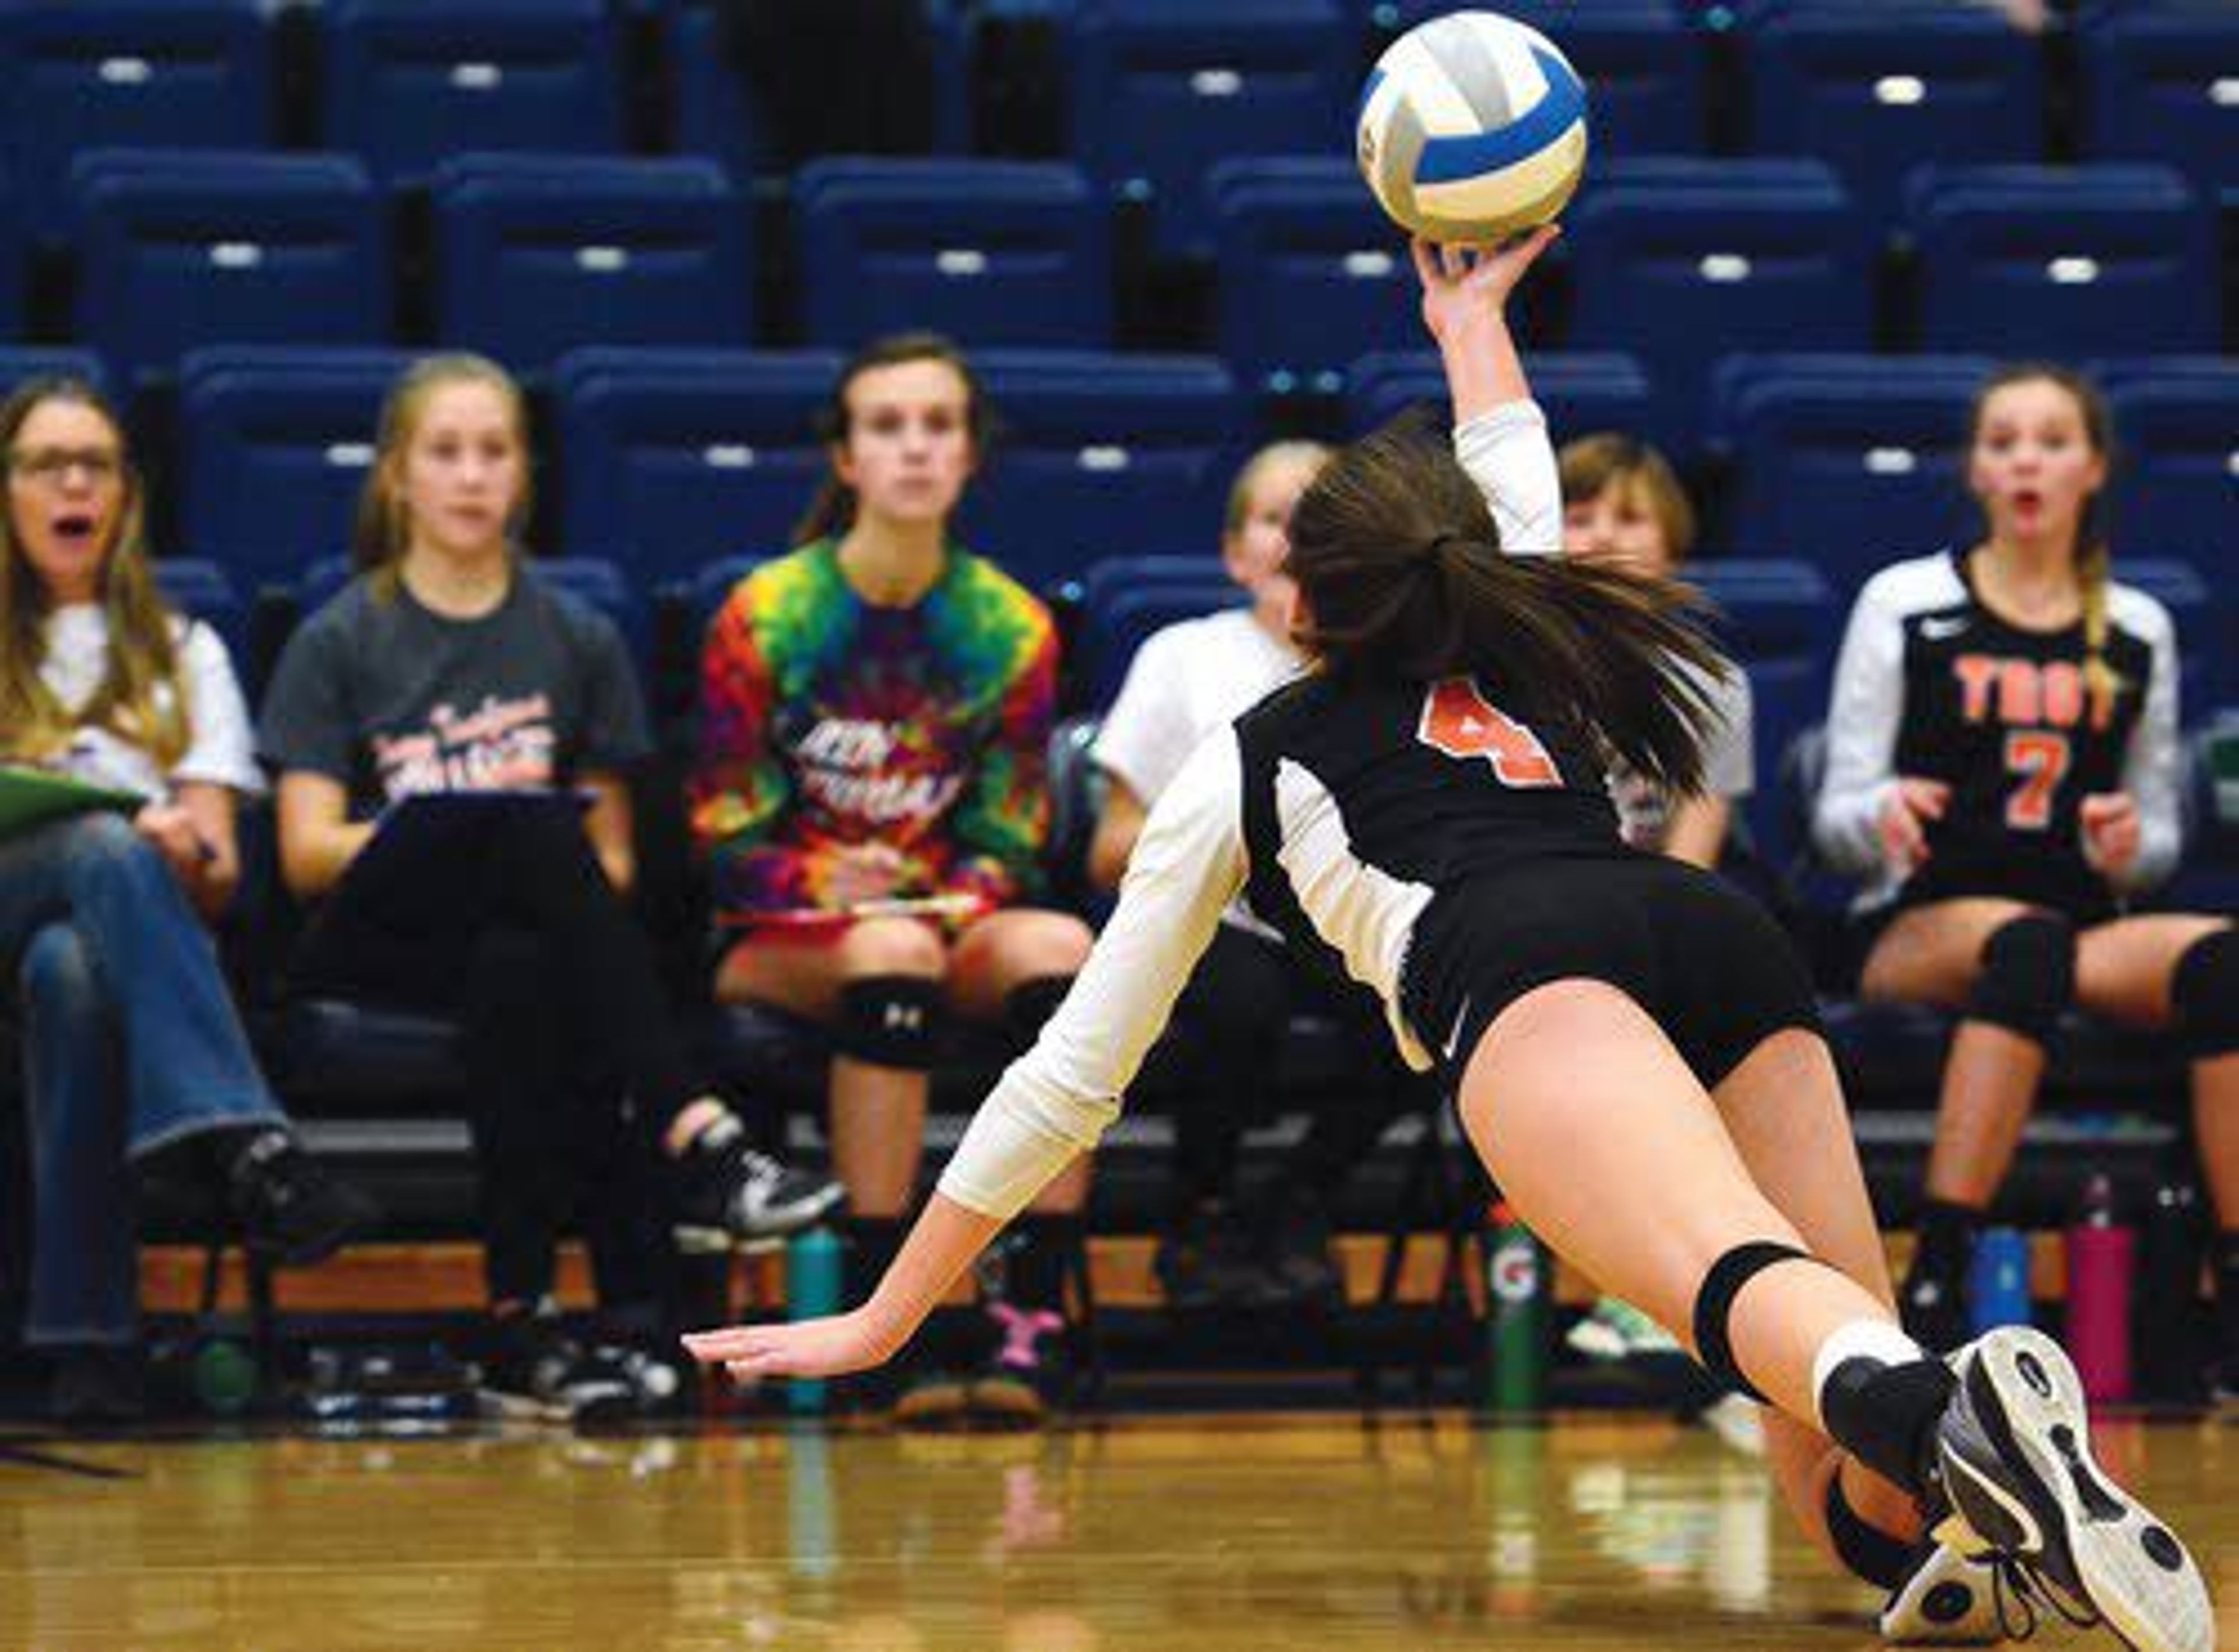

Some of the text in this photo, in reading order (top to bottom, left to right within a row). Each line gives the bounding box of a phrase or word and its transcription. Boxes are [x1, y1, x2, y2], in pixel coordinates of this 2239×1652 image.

[1417, 678, 1566, 788] 4
[2006, 731, 2069, 827] 7
[1492, 1245, 1536, 1301] G
